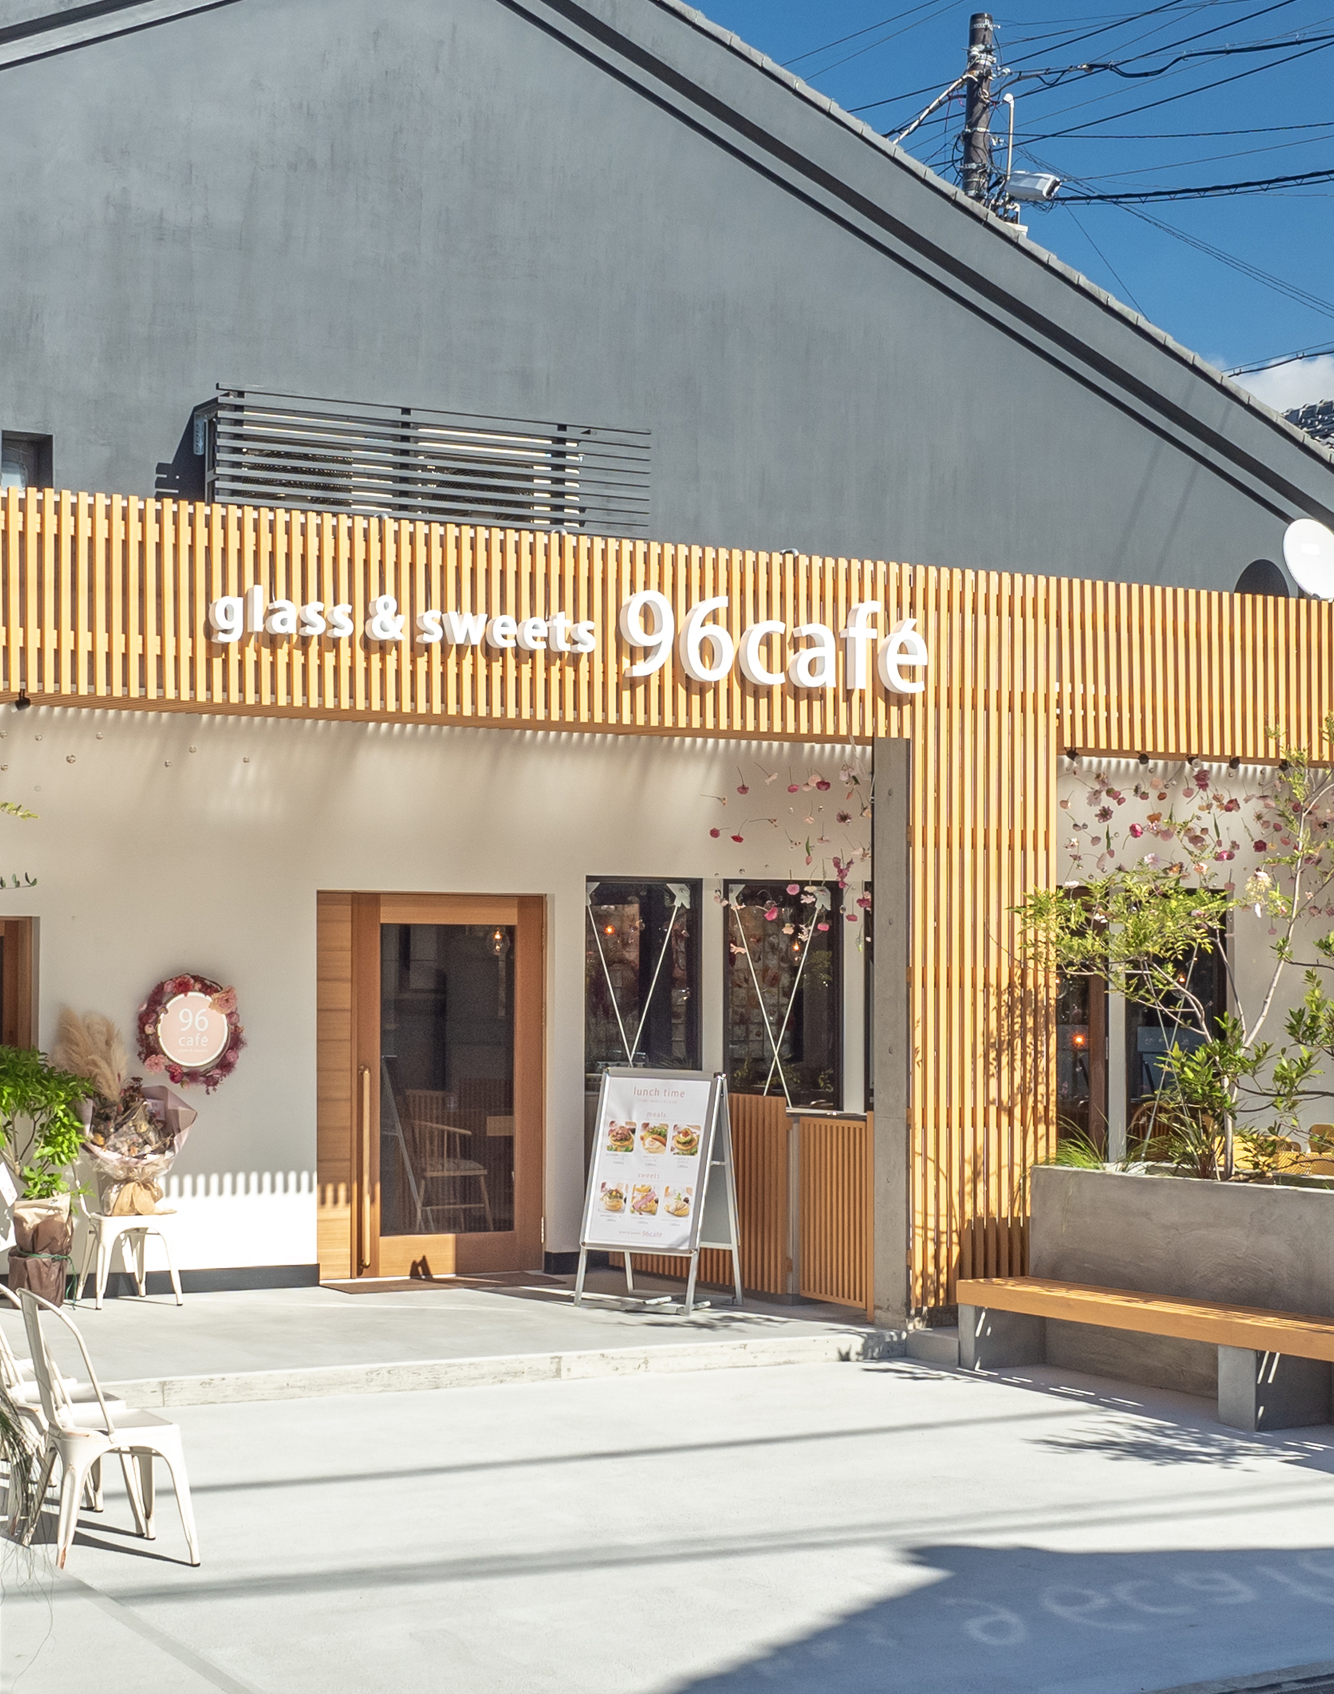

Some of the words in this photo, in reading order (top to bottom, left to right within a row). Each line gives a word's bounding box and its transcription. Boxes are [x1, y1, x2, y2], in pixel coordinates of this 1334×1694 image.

[208, 584, 355, 644] glass
[365, 594, 406, 641] &
[416, 608, 597, 654] sweets
[620, 589, 929, 694] 96café
[178, 1007, 209, 1032] 96
[633, 1086, 660, 1097] lunch
[663, 1088, 686, 1099] time
[646, 1111, 667, 1119] meals
[637, 1172, 661, 1180] sweets
